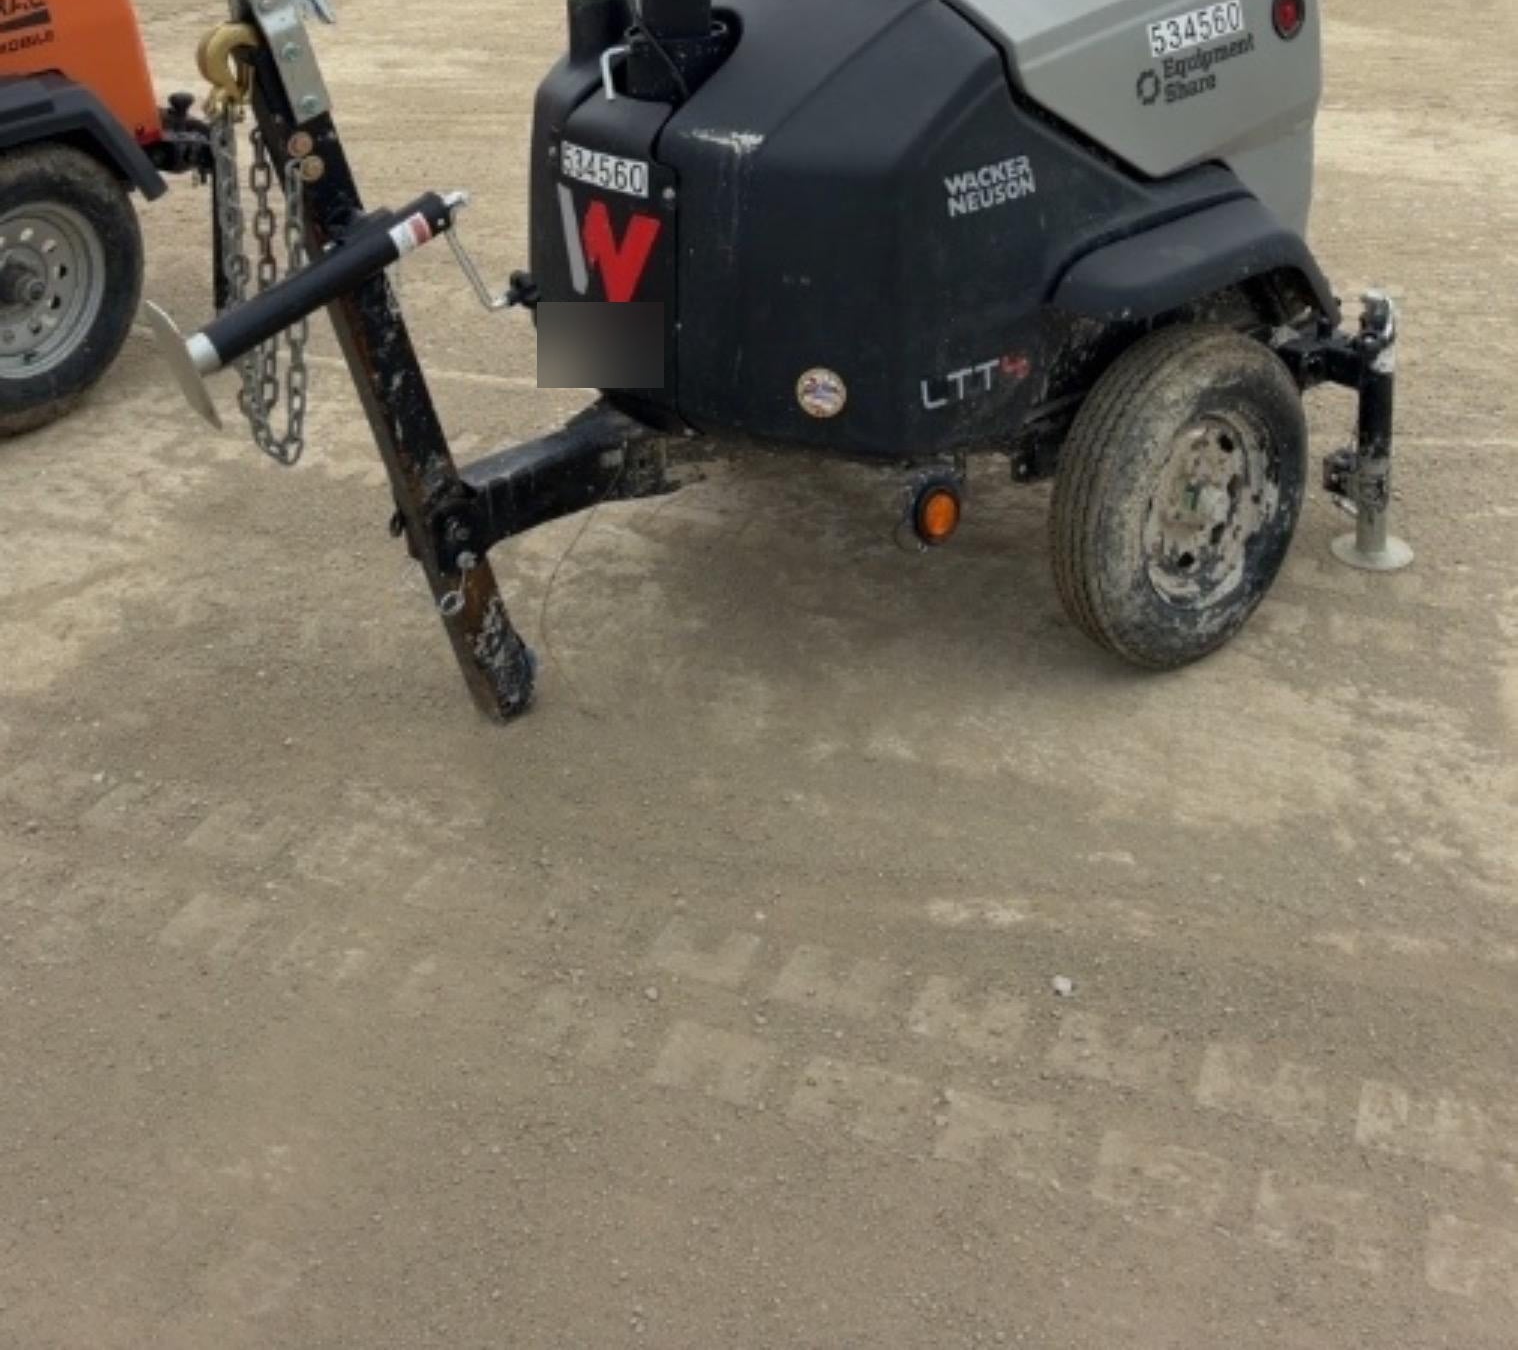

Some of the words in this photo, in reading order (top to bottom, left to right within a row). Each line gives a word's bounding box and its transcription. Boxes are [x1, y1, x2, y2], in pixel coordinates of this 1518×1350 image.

[1150, 2, 1241, 55] 534560
[1162, 33, 1255, 79] Equipment
[1164, 74, 1217, 103] Share
[562, 145, 645, 193] 534560
[944, 155, 1031, 195] WACKER
[947, 172, 1036, 217] NEUSON
